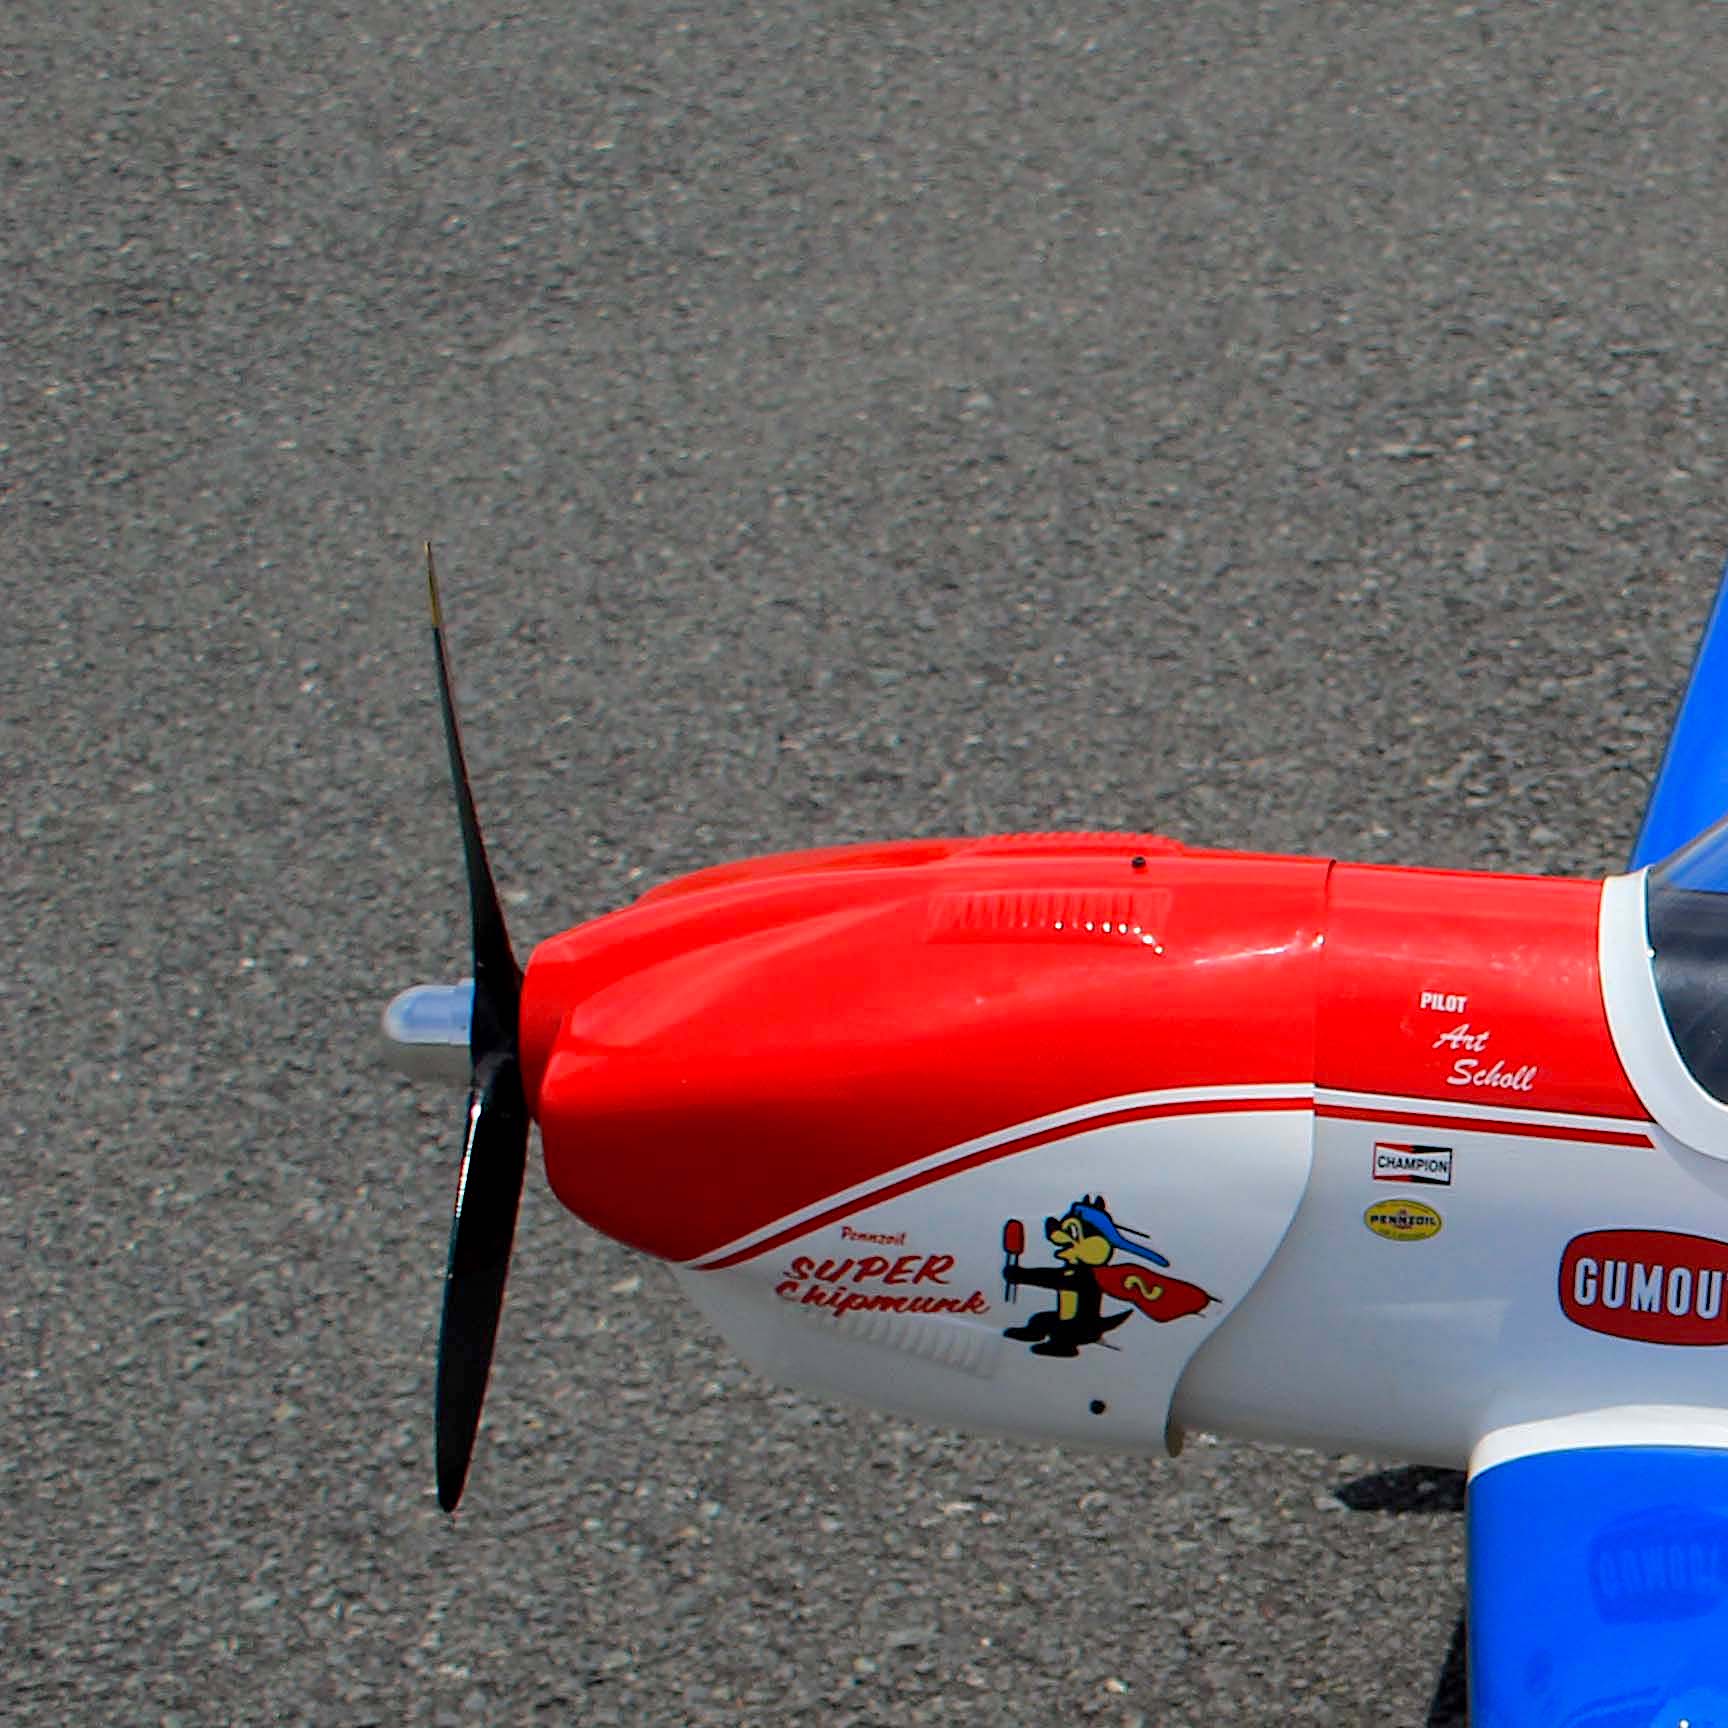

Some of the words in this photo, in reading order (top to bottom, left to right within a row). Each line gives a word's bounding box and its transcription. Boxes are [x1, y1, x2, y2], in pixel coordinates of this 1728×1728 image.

[1420, 992, 1467, 1013] PILOT
[1432, 1023, 1490, 1052] Art
[1446, 1058, 1538, 1091] Scholl
[1377, 1156, 1447, 1173] CHAMPION
[783, 1254, 955, 1285] SUPER
[775, 1281, 991, 1317] Chipmunk
